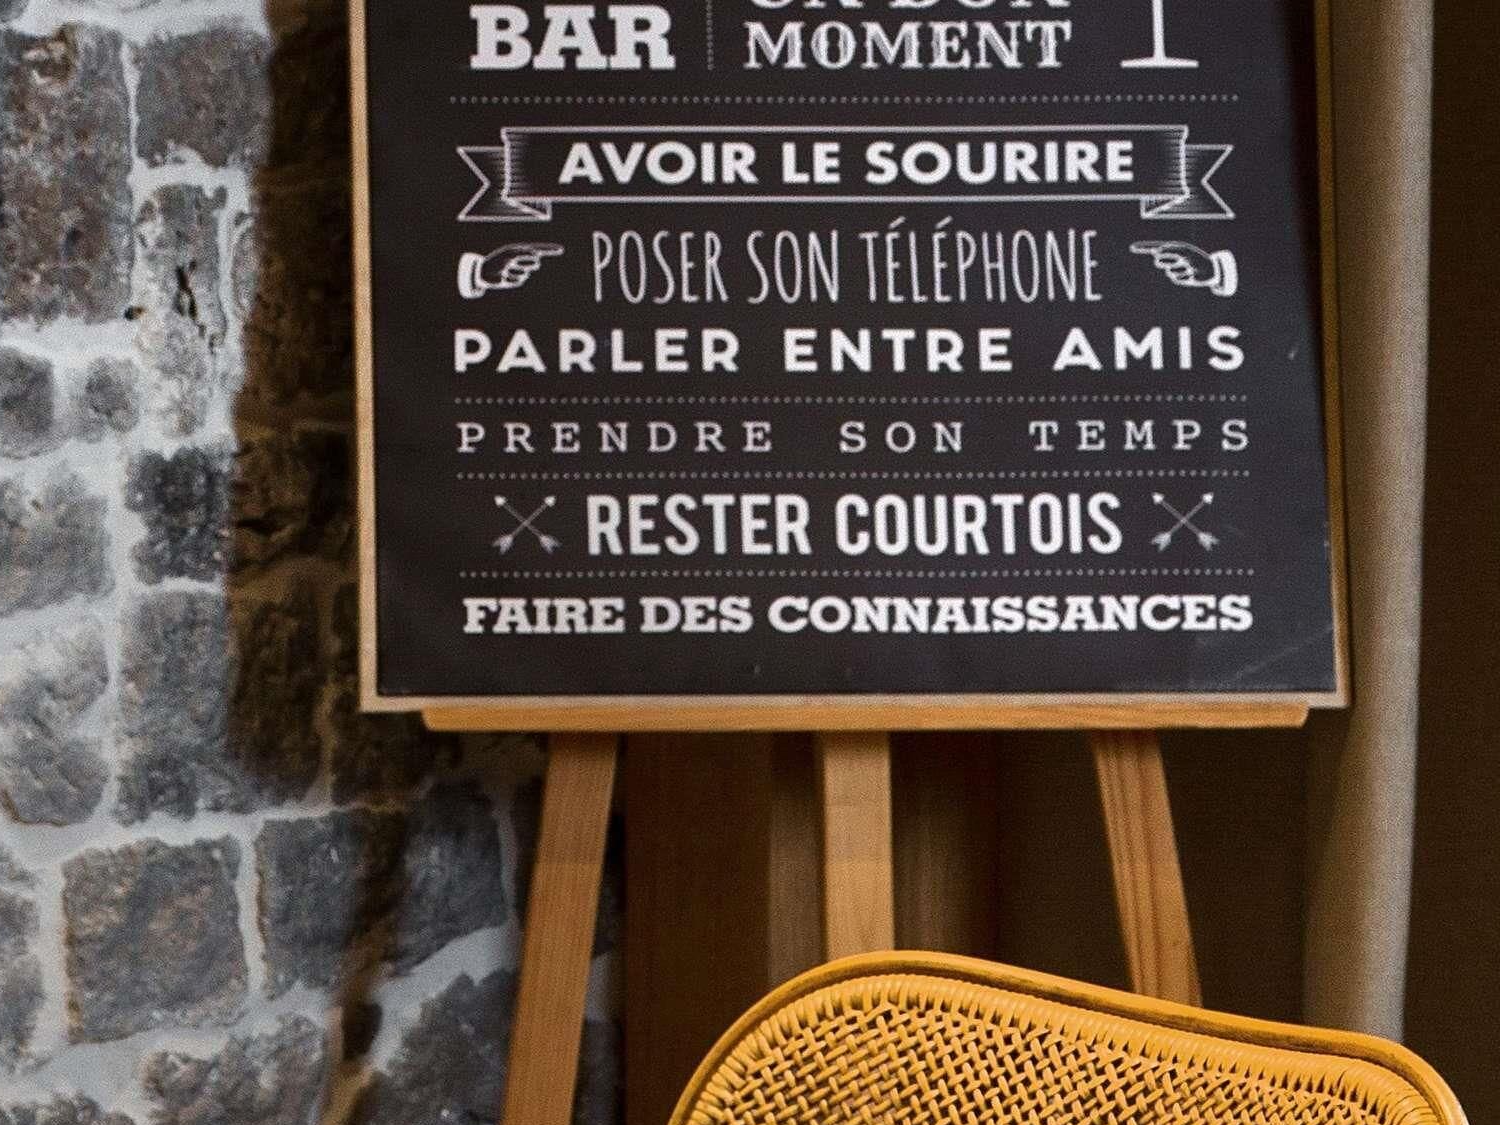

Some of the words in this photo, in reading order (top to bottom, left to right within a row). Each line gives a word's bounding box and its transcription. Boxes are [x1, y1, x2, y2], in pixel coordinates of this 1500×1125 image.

[469, 4, 676, 70] BAR
[744, 20, 1072, 69] MOMENT
[558, 141, 758, 185] AVOIR
[781, 141, 841, 184] LE
[865, 140, 1134, 185] SOURIRE
[592, 230, 729, 304] POSER
[746, 229, 840, 304] SON
[858, 215, 1103, 304] TÉLÉPHONE
[454, 328, 740, 373] PARLER
[783, 327, 1013, 373] ENTRE
[1052, 325, 1245, 372] AMIS
[457, 421, 772, 453] PRENDRE
[839, 420, 963, 453] SON
[1028, 418, 1249, 452] TEMPS
[586, 493, 812, 556] RESTER
[834, 491, 1123, 557] COURTOIS
[462, 597, 626, 634] FAIRE
[639, 596, 754, 633] DES
[767, 593, 1254, 634] CONNAISSANCES
